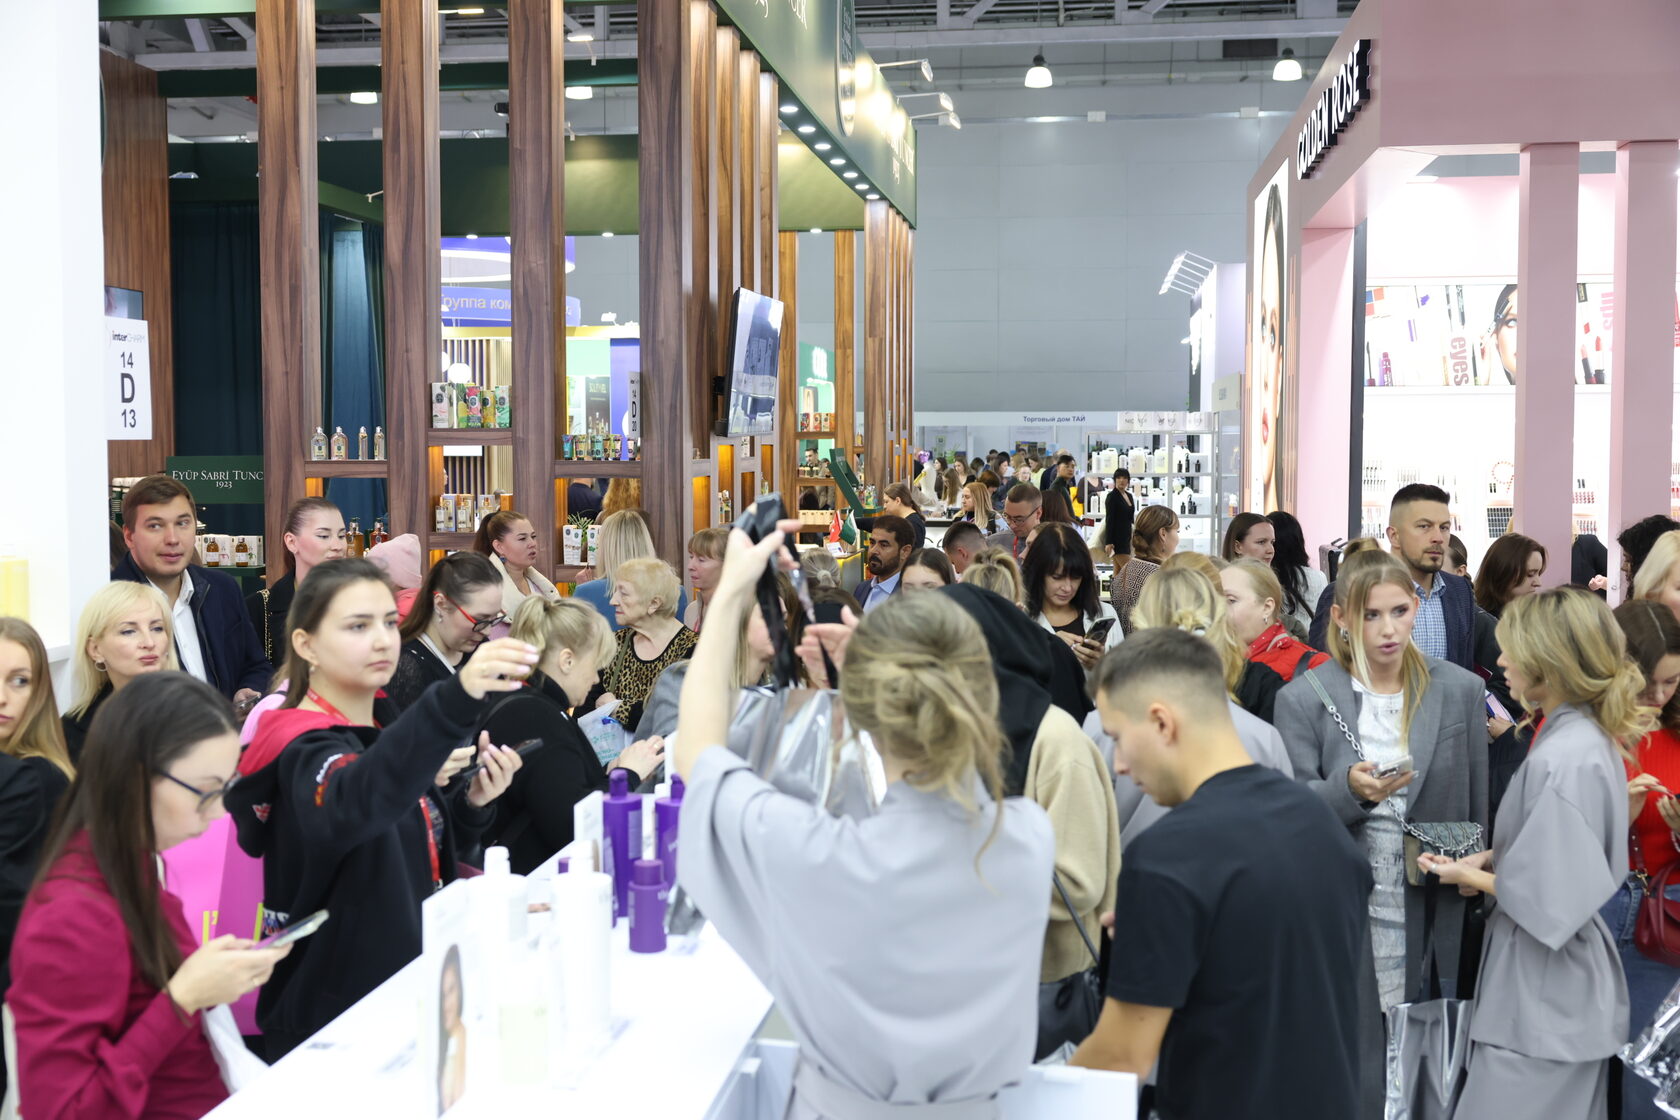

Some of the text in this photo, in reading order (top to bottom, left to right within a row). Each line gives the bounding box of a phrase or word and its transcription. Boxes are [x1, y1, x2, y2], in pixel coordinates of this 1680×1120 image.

[1296, 39, 1361, 181] GOLDEN ROSE
[441, 294, 487, 312] руппа
[120, 350, 134, 369] 14
[1450, 336, 1470, 387] eyes
[120, 372, 136, 404] D
[121, 408, 137, 429] 13
[631, 400, 637, 419] D
[1023, 414, 1086, 424] Торговый дом ТАЙ
[171, 469, 199, 481] EYÜP
[215, 481, 233, 489] 1923
